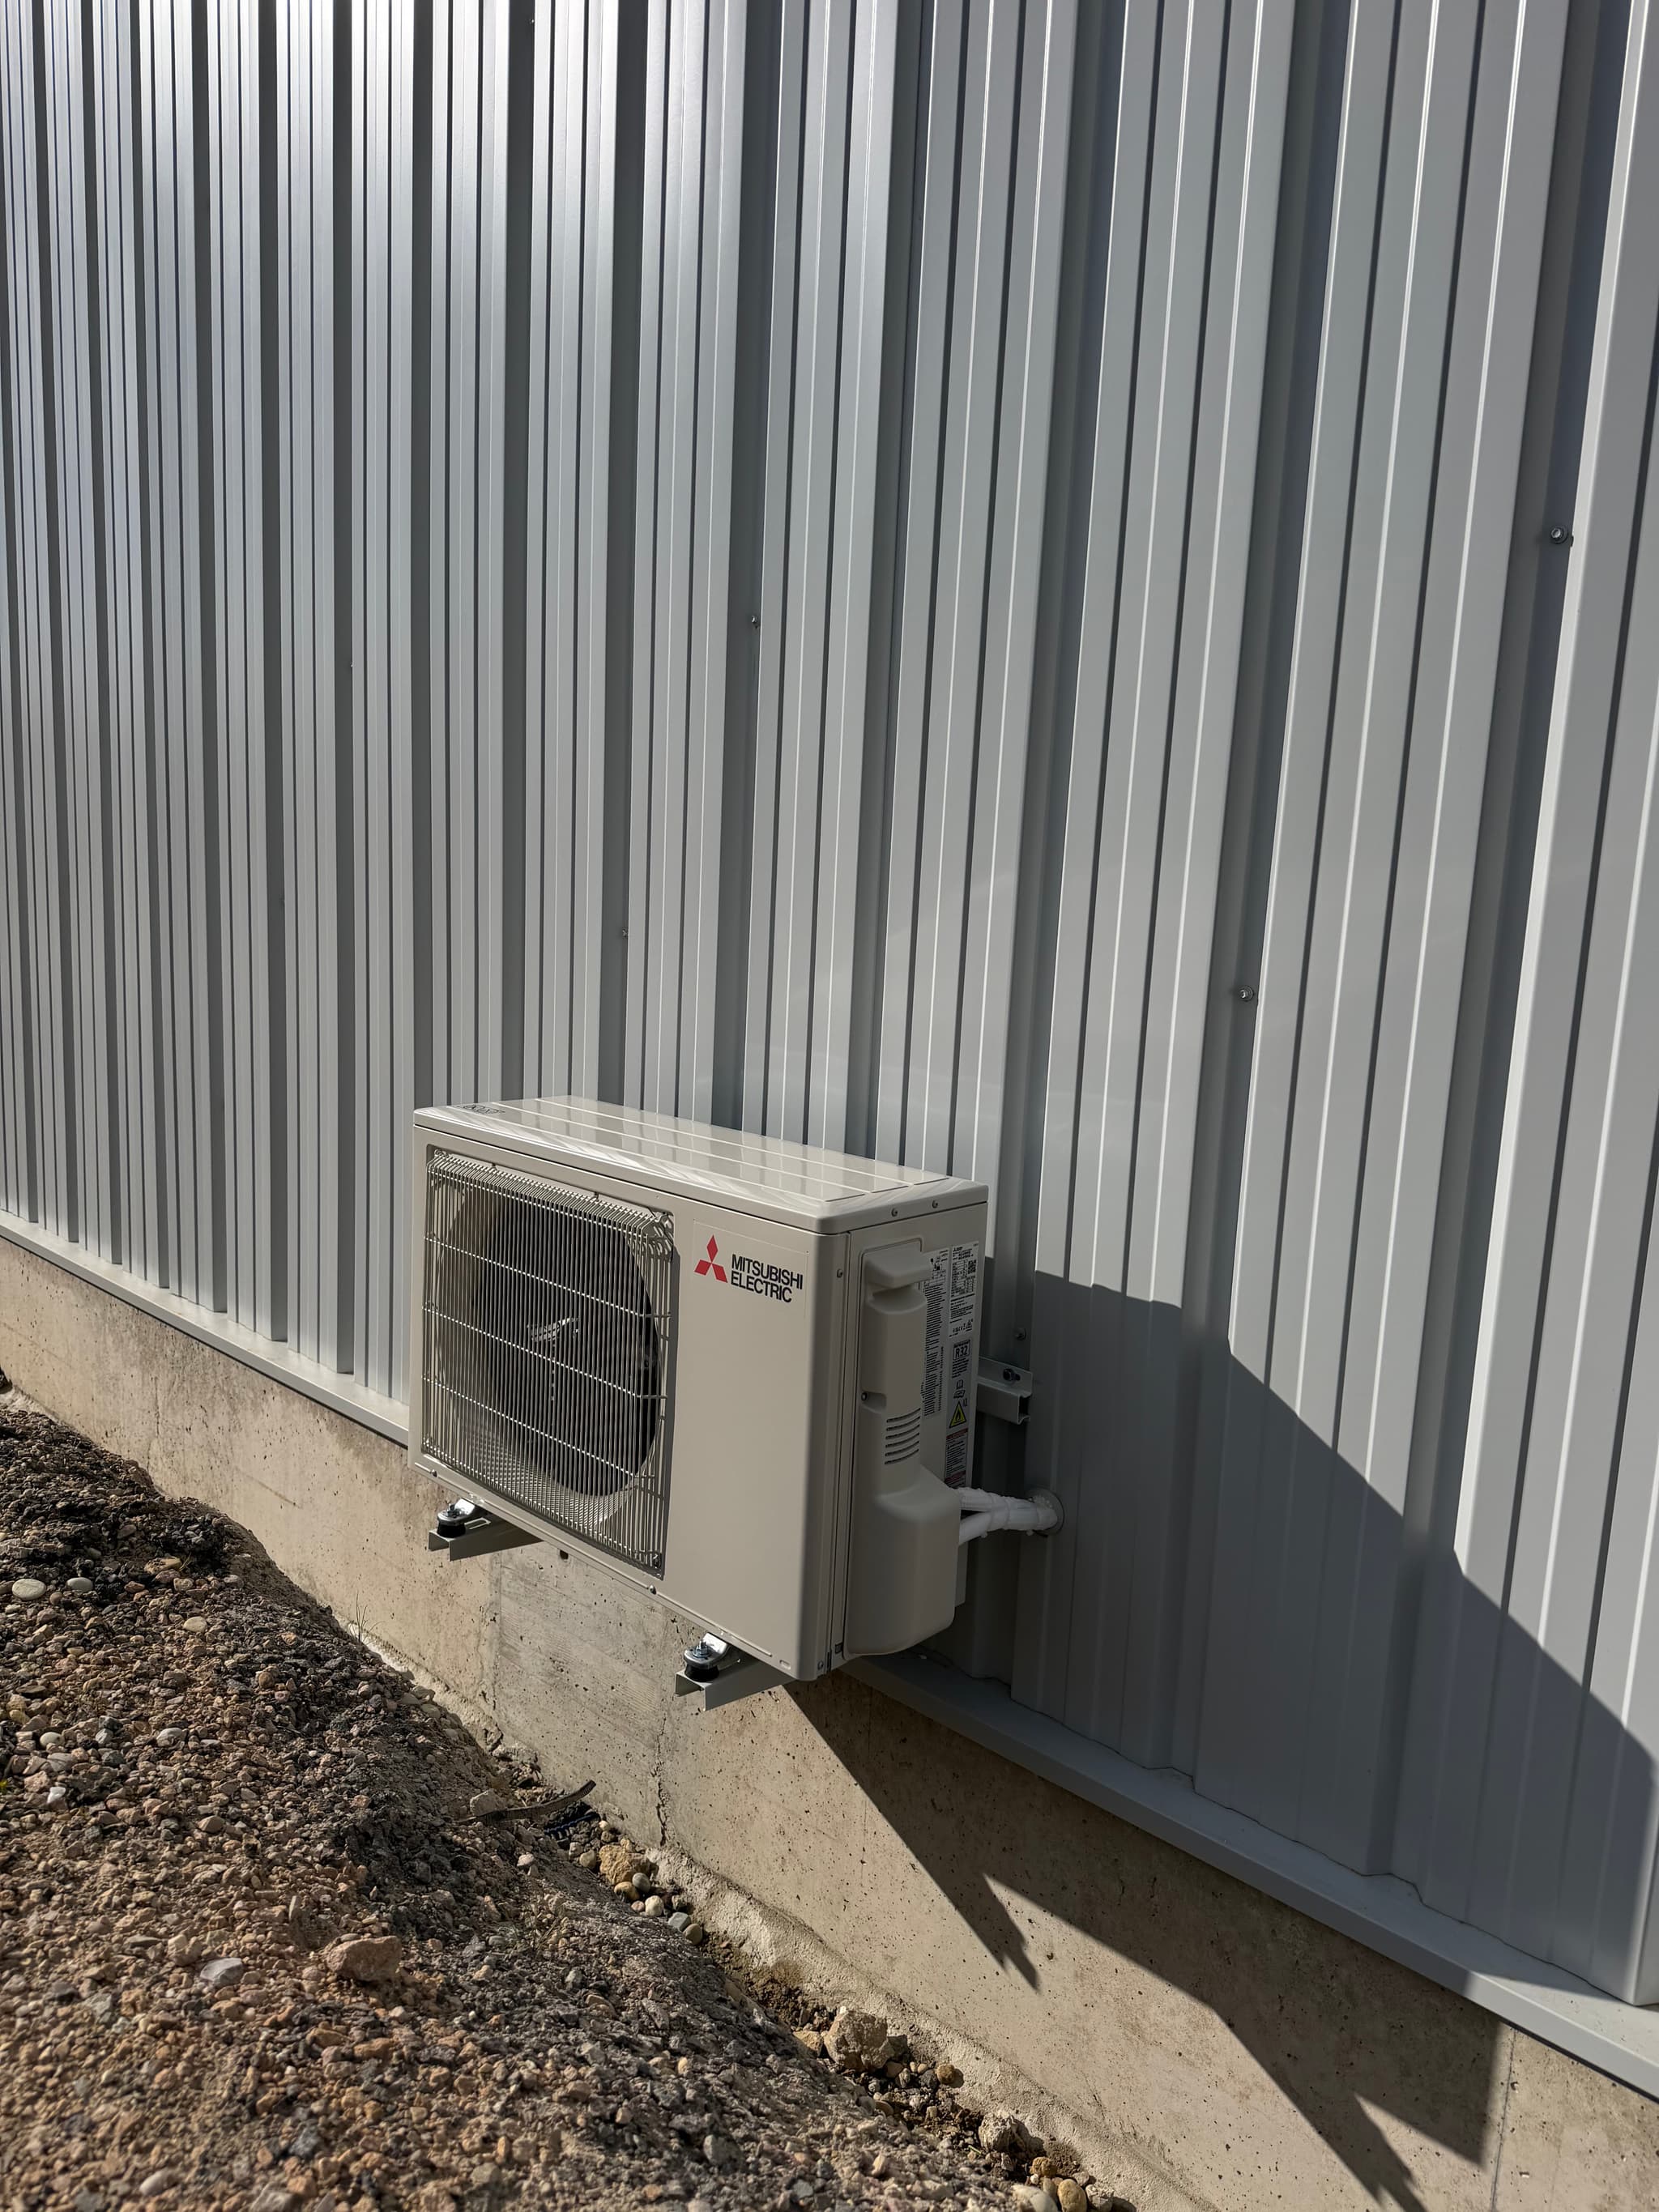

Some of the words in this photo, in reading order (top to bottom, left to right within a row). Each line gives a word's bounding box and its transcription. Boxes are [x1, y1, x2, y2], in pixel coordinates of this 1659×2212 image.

[731, 1254, 804, 1289] MITSUBISHI
[731, 1270, 792, 1302] ELECTRIC
[955, 1345, 968, 1358] R32
